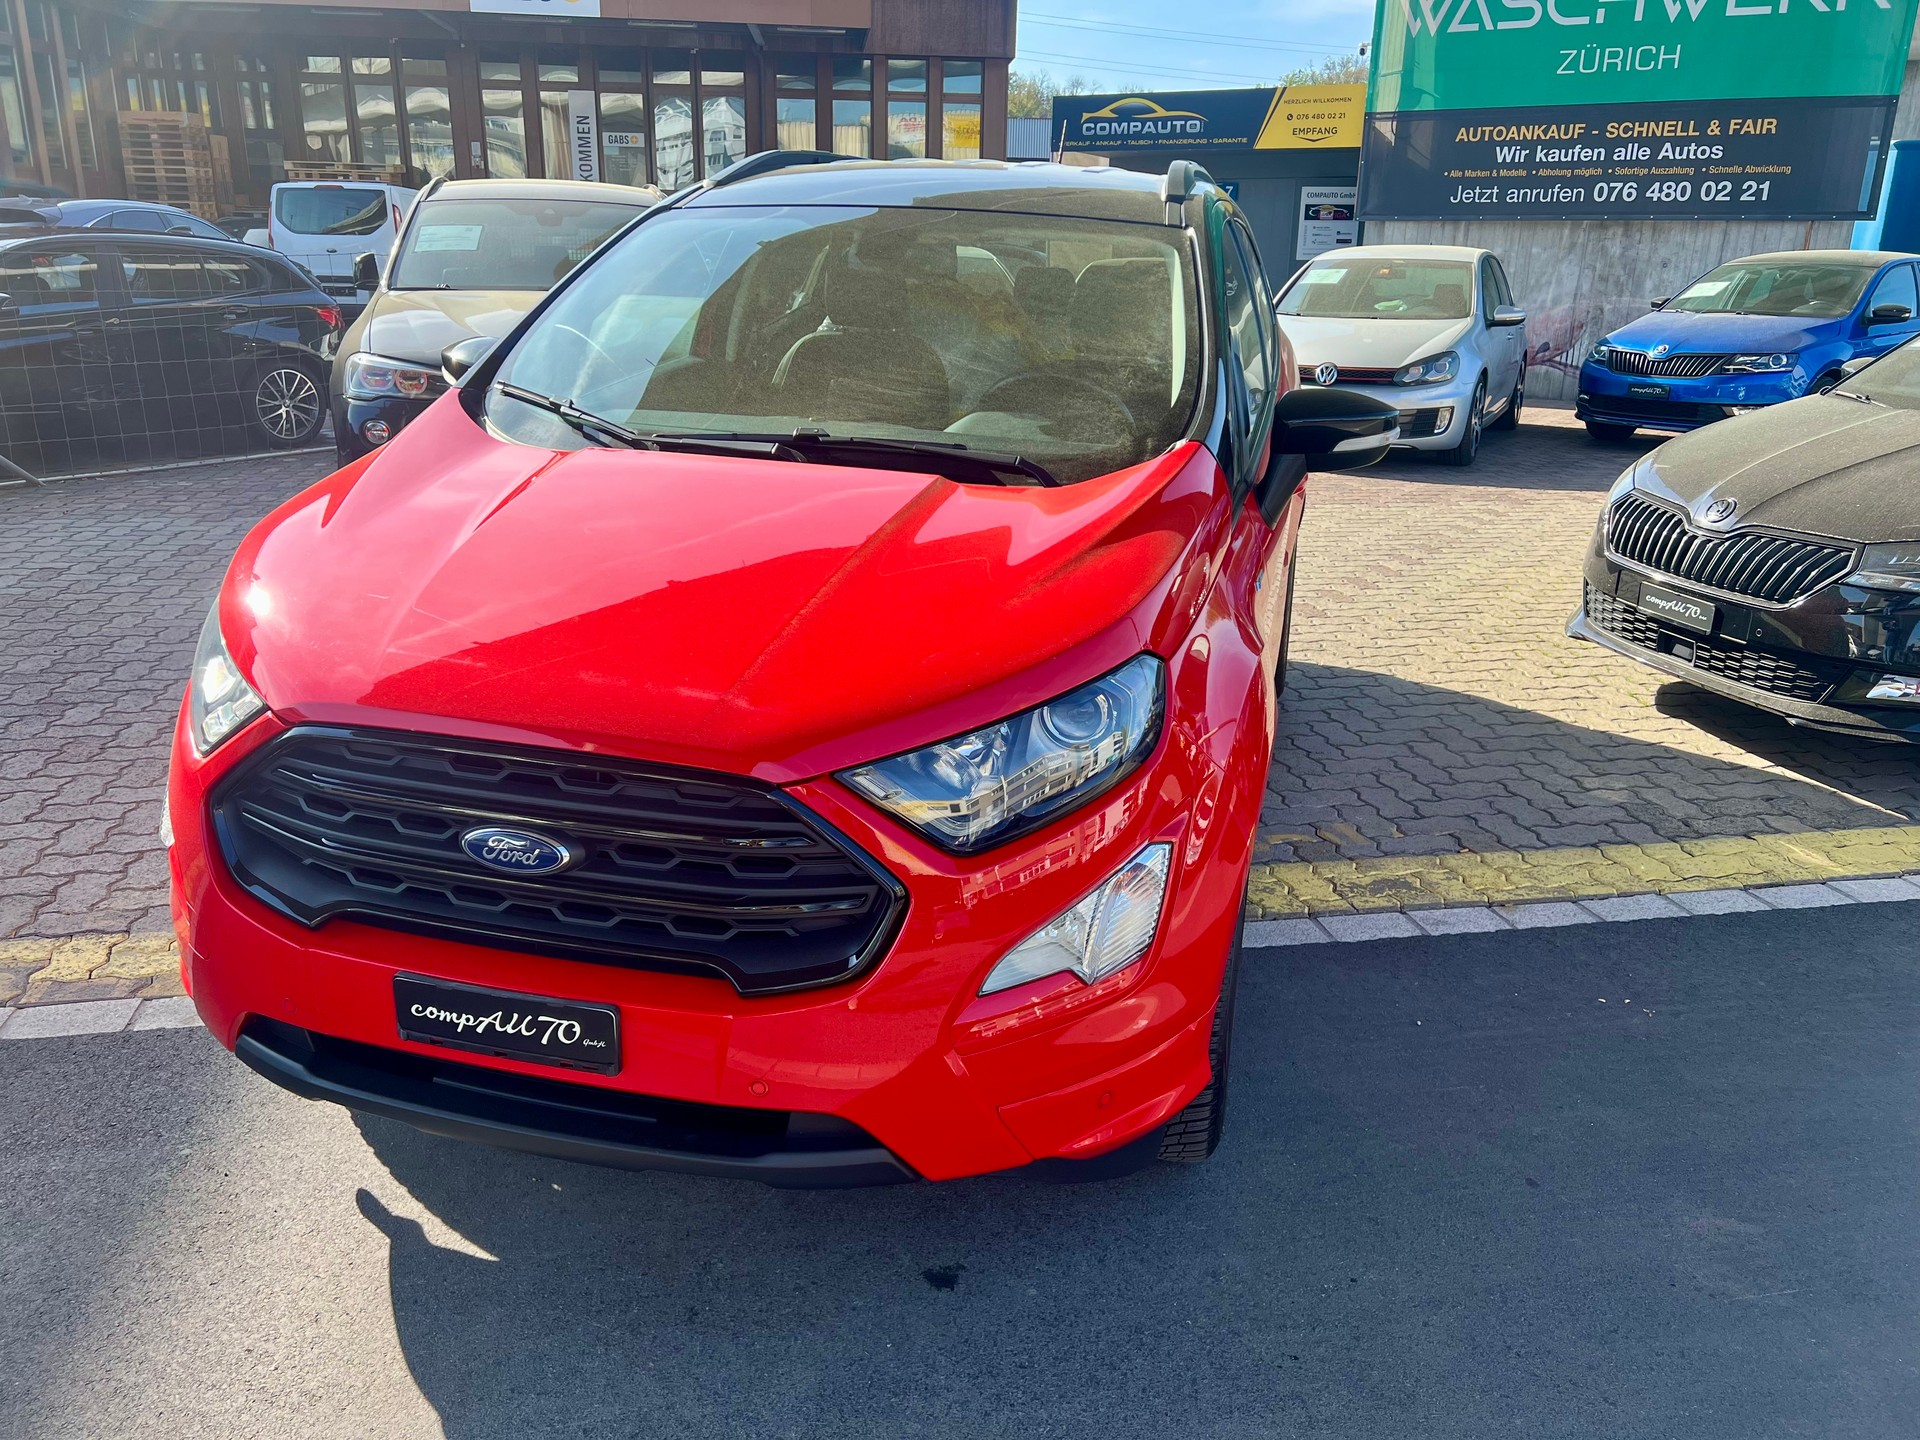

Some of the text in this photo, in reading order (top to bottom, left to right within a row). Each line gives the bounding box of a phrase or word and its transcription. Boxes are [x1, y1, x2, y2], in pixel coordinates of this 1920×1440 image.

[1401, 0, 1892, 38] WASCH
[1556, 44, 1681, 74] ZÜRICH
[1082, 120, 1200, 136] COMPAUTO
[1292, 127, 1338, 135] EMPFANG
[1455, 123, 1586, 142] AUTOANKAUF
[1605, 120, 1700, 138] SCHNELL
[1707, 119, 1721, 136] &
[1728, 118, 1778, 135] FAIR
[608, 134, 630, 144] GABS
[576, 115, 593, 182] KOMMEN
[1495, 142, 1724, 163] Wir kaufen alle Autos
[1450, 168, 1527, 177] Alle Marken & Modelle
[1537, 167, 1603, 177] Abholung möglich
[1614, 166, 1695, 176] Sofortige Auszahlung
[1708, 164, 1792, 174] Schnelle Abwicklung
[1306, 191, 1339, 199] COMPAUTO
[1450, 180, 1771, 203] Jetzt anrufen 076 480 02 21
[482, 835, 541, 867] Ford
[582, 1038, 607, 1048] GmbH
